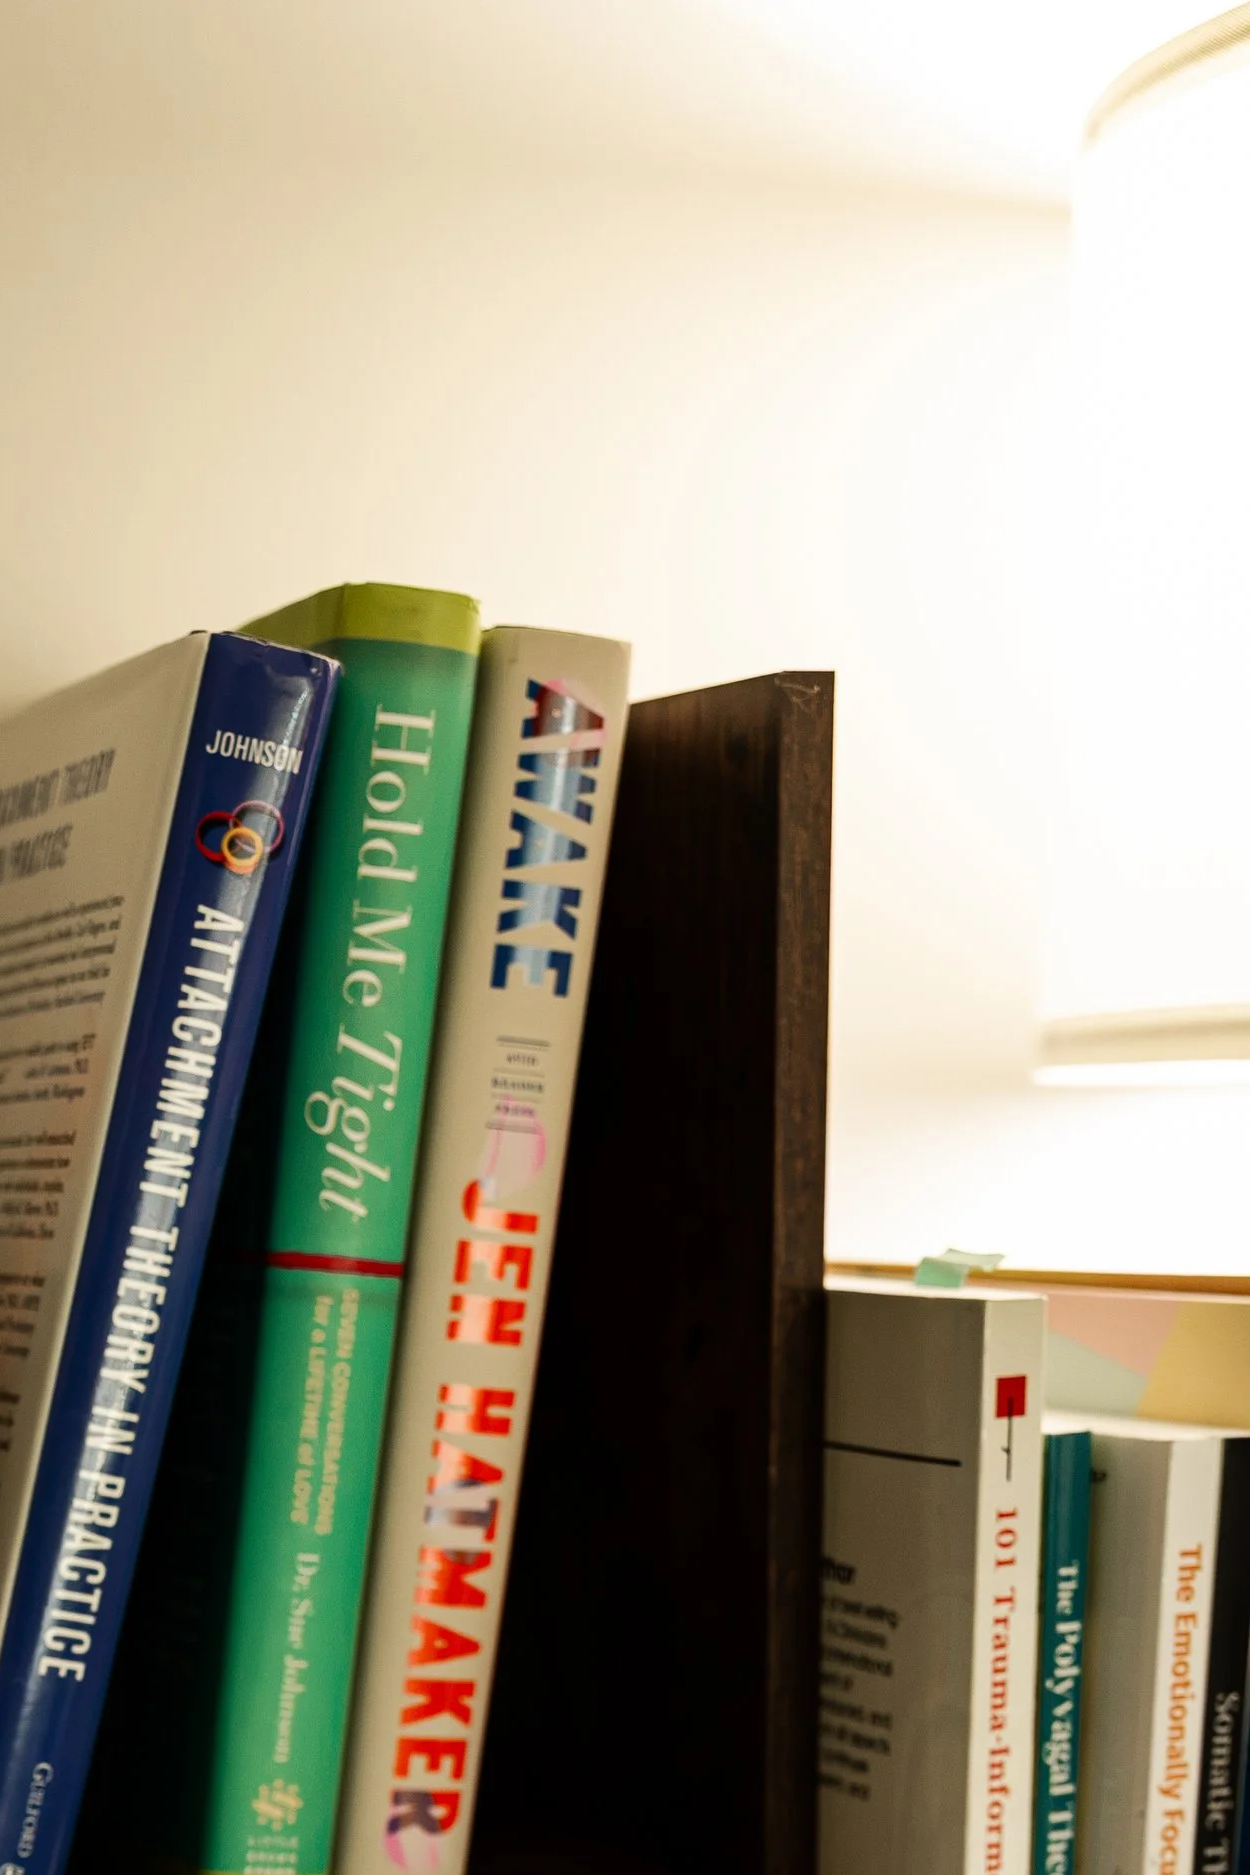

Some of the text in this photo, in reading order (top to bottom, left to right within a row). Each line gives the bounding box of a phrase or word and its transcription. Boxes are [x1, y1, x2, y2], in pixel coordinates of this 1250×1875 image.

[205, 729, 304, 775] JOHNSON
[490, 676, 607, 998] AWAKE
[304, 704, 437, 1224] Hold Me Tight
[38, 904, 245, 1682] ATTACHMENT THEORY IN PRACTICE
[445, 1179, 540, 1347] JEN
[386, 1382, 516, 1837] HATMAKER
[994, 1507, 1018, 1571] 101
[1055, 1563, 1078, 1616] The
[1178, 1543, 1204, 1602] The
[1041, 1618, 1081, 1796] Polyvagal
[1159, 1608, 1199, 1804] Emotionally
[1204, 1690, 1241, 1833] Somatic
